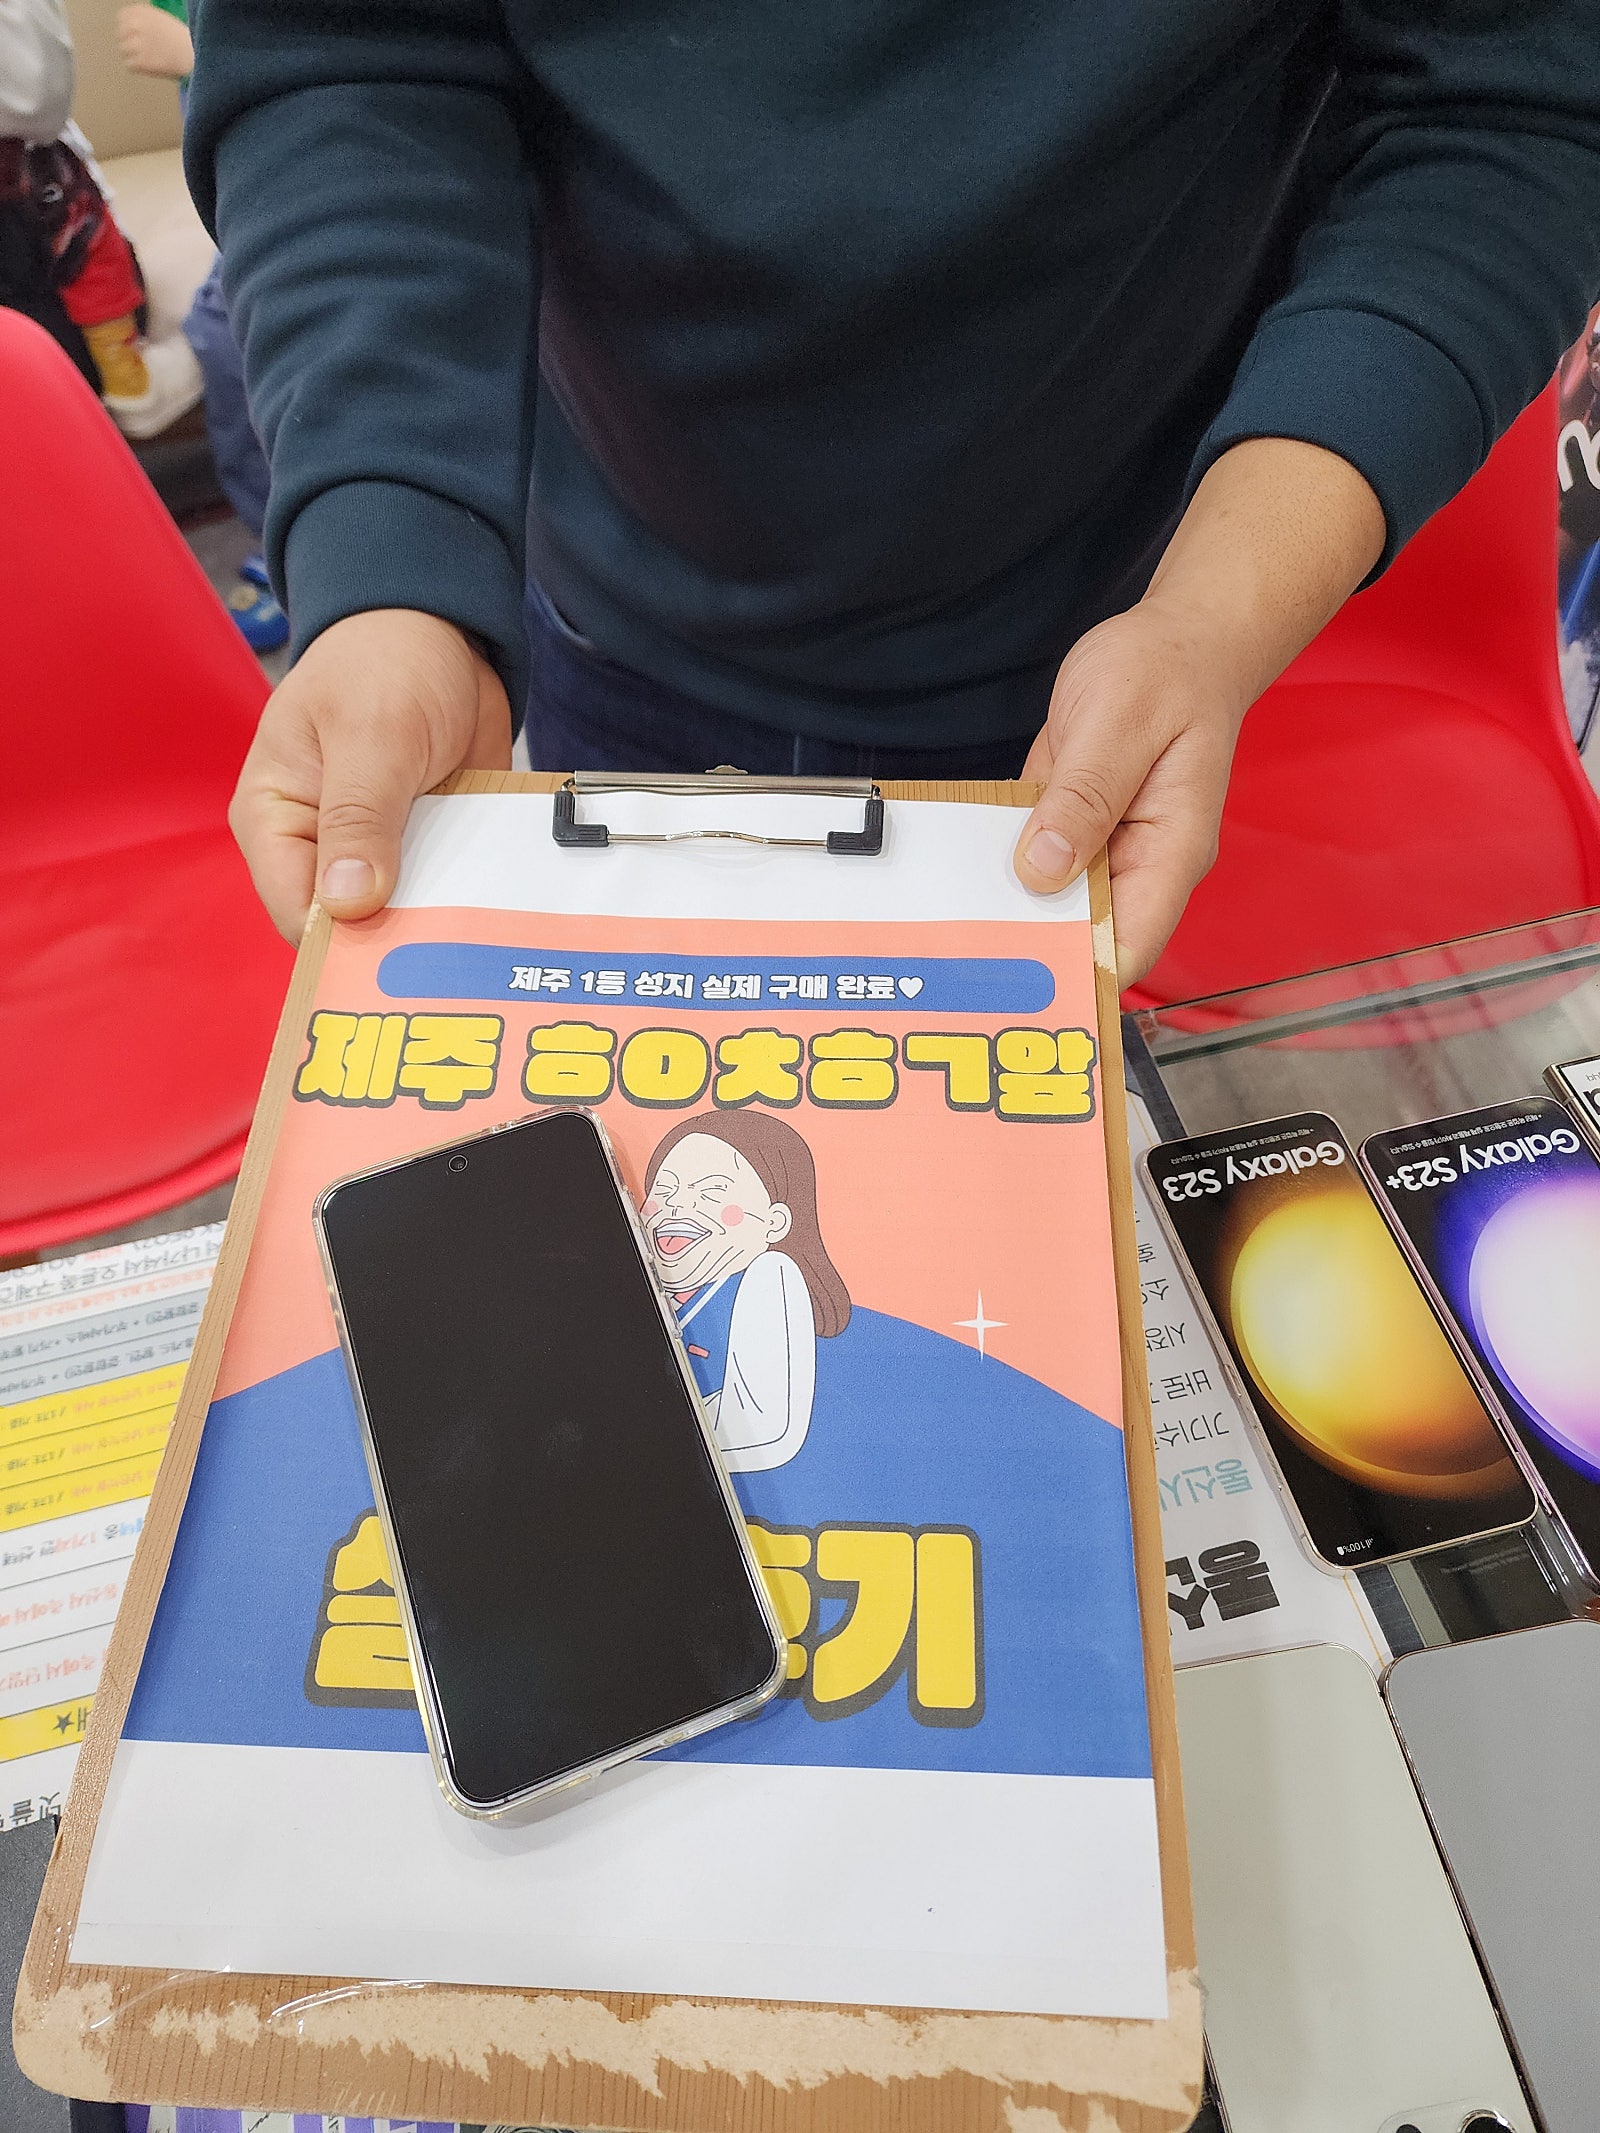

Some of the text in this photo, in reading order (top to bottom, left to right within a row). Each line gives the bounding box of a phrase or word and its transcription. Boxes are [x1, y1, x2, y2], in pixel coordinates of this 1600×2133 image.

[508, 965, 571, 993] 제주
[580, 969, 627, 996] 1등
[633, 970, 695, 1000] 성지
[701, 974, 762, 1000] 실제
[768, 974, 829, 1000] 구매
[293, 1009, 505, 1111] 제주
[1162, 1141, 1346, 1202] Galaxy S23
[1385, 1128, 1580, 1192] Galaxy S23+
[1154, 1411, 1230, 1450] 기기수
[1343, 1541, 1366, 1553] 100%
